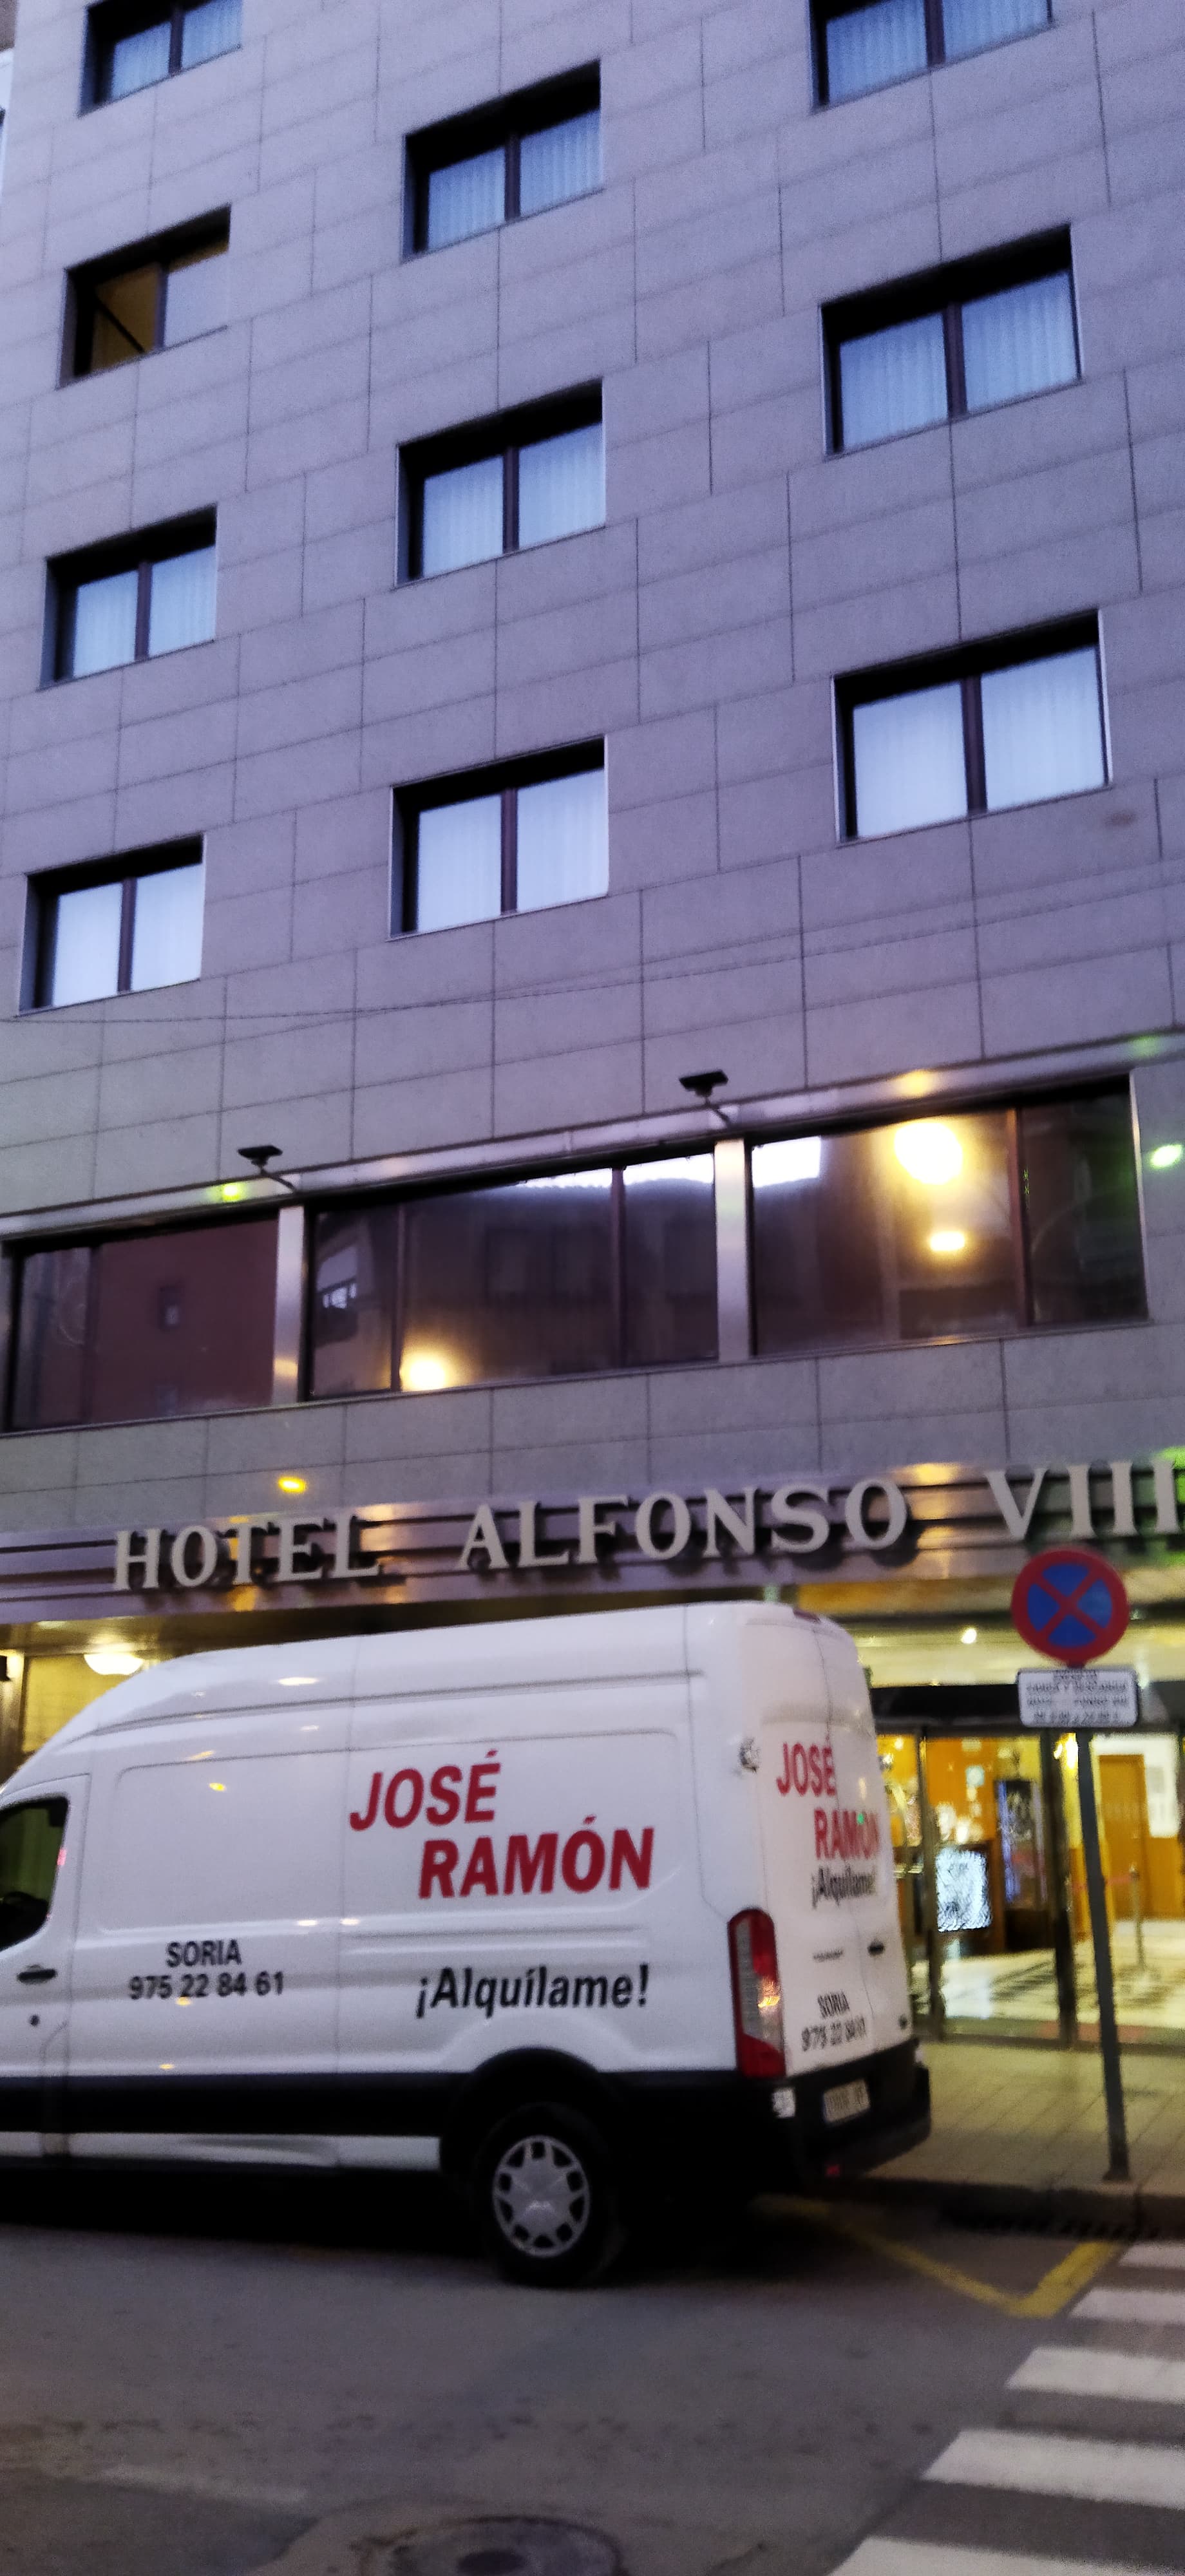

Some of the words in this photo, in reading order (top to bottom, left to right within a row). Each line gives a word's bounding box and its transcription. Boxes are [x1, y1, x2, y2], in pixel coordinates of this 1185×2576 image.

[114, 1514, 381, 1592] HOTEL
[456, 1481, 907, 1570] ALFONSO
[984, 1459, 1180, 1541] VIII
[349, 1749, 501, 1832] JOSÉ
[776, 1734, 836, 1797] JOSÉ
[419, 1815, 654, 1899] RAMÓN
[166, 1938, 242, 1967] SORIA
[129, 1975, 173, 2000] 975
[179, 1973, 209, 1998] 22
[217, 1971, 247, 1997] 84
[254, 1970, 283, 1996] 61
[416, 1962, 649, 2019] ¡Alquílame!
[817, 1991, 850, 2019] SORIA
